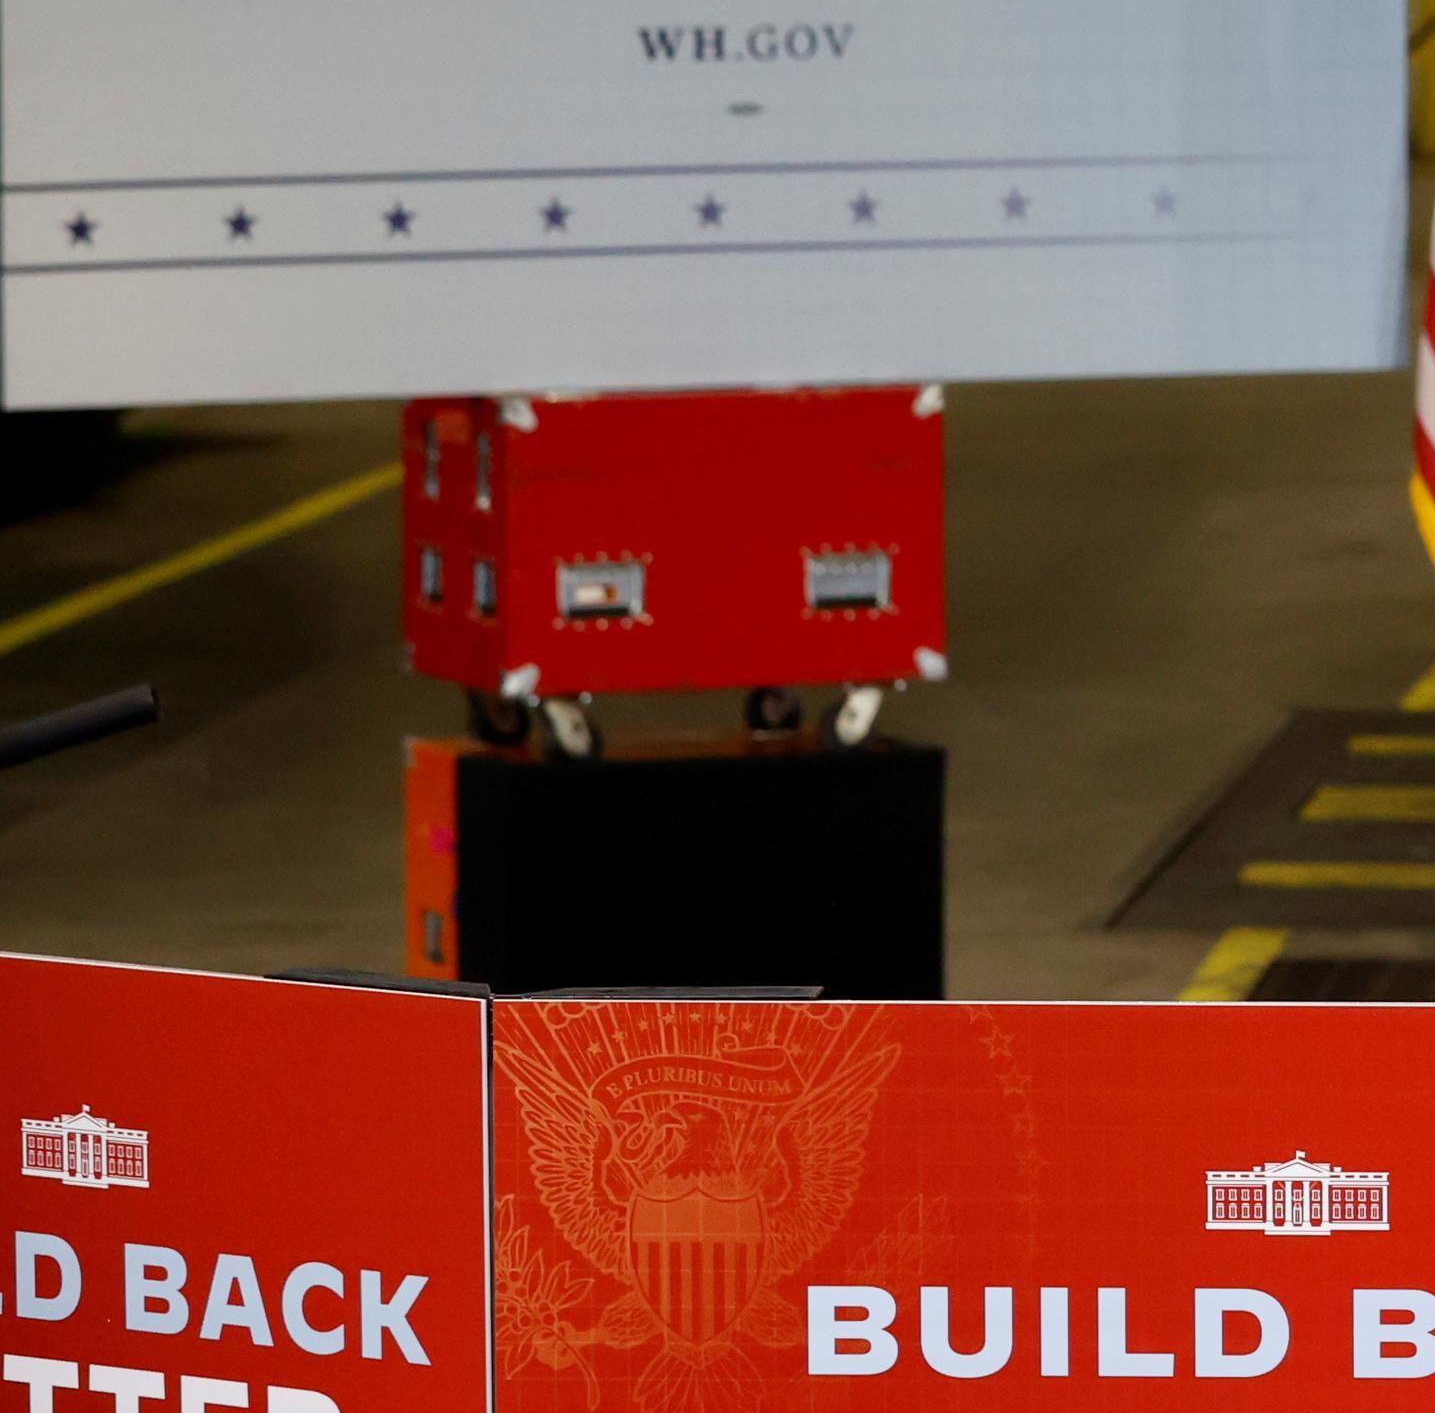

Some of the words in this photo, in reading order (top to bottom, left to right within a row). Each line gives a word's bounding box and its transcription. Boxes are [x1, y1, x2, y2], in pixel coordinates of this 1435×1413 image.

[638, 21, 856, 64] WH.GOV
[606, 1082, 622, 1099] E
[623, 1066, 723, 1090] PLURIBUS
[728, 1074, 793, 1096] UNUM
[123, 1242, 433, 1367] BACK
[806, 1284, 1291, 1380] BUILD
